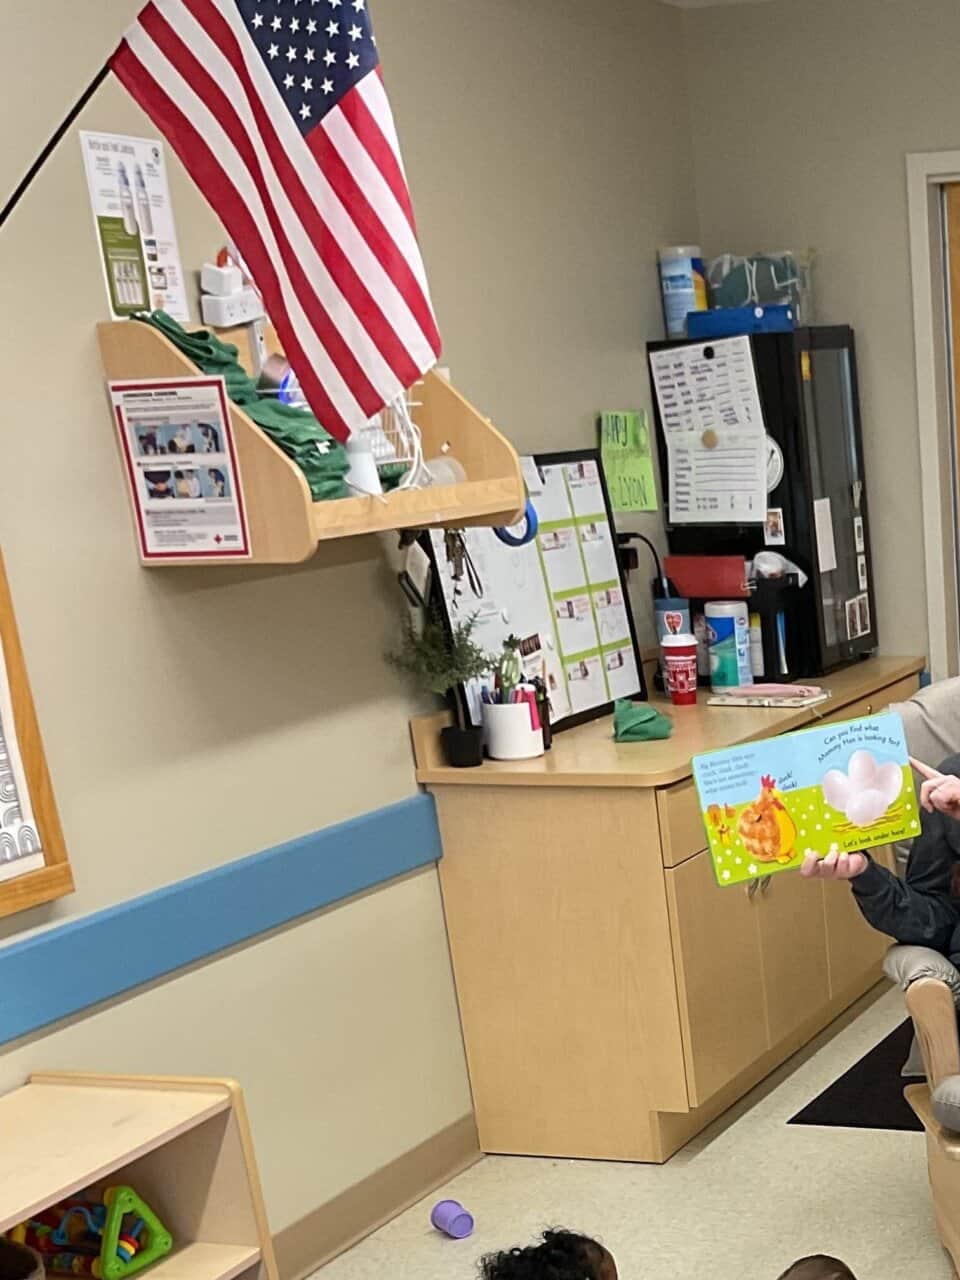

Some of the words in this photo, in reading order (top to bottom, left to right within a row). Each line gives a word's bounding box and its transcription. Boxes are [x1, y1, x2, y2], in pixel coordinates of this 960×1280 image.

[824, 735, 836, 745] Can
[838, 730, 848, 740] you
[864, 723, 880, 732] what
[864, 734, 887, 744] looking
